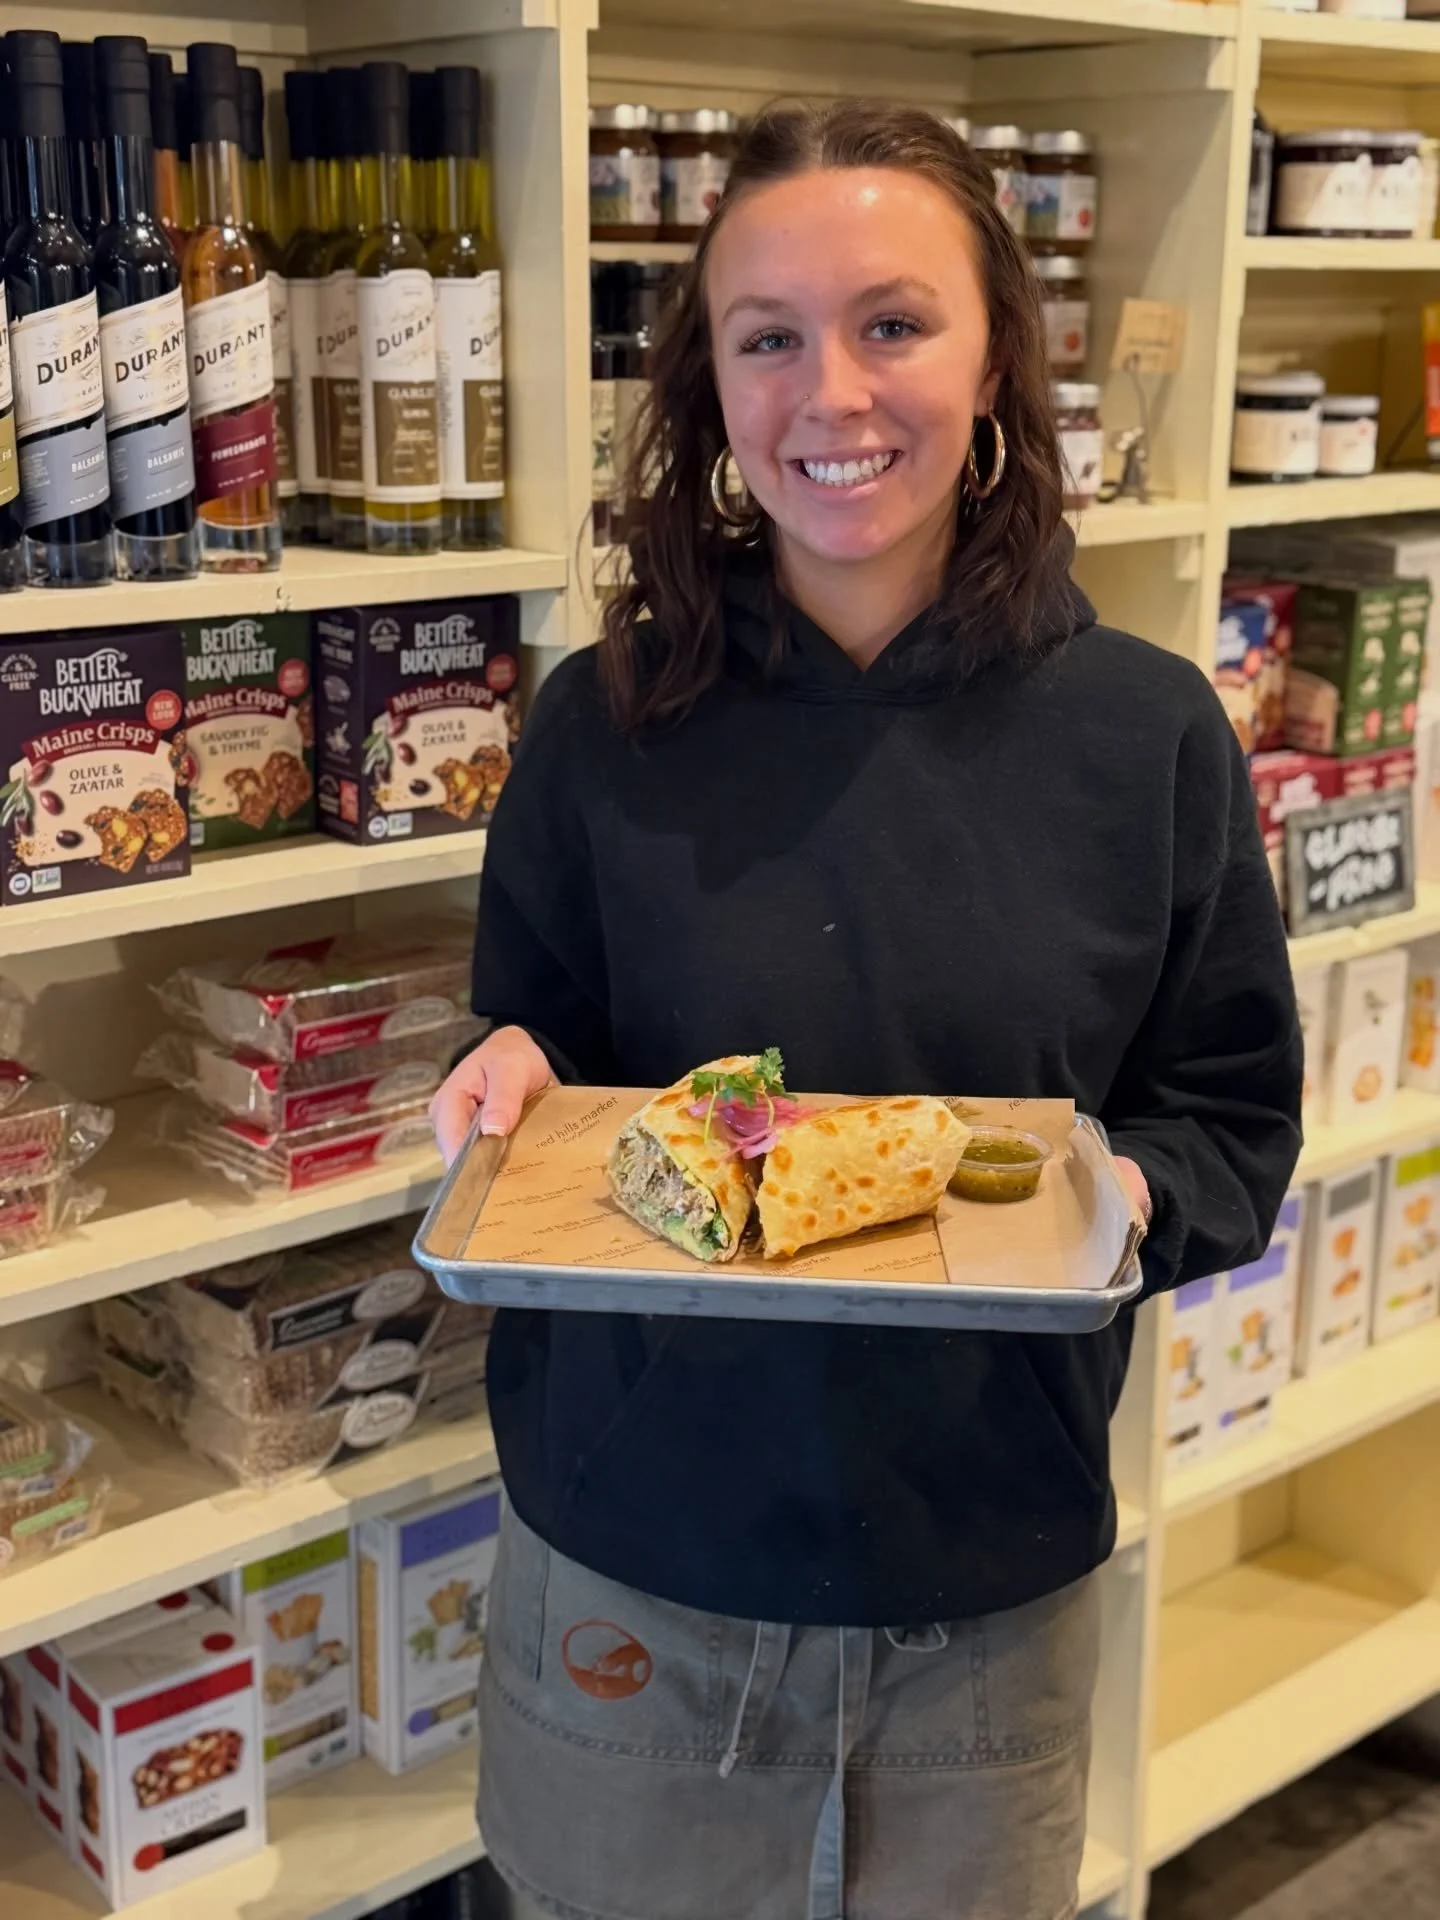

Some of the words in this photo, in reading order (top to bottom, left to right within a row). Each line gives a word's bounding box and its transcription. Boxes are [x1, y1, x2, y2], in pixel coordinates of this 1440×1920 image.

[194, 323, 266, 377] DURANT
[326, 325, 358, 355] DUR
[376, 316, 432, 357] DURA
[37, 334, 99, 385] DURAN
[115, 329, 184, 384] DURANT
[200, 621, 257, 654] BETTER
[415, 616, 468, 648] BETTER
[56, 650, 121, 686] BETTER
[186, 647, 276, 684] BUCKWHEAT
[400, 643, 486, 677] BUCKWHEAT
[40, 679, 143, 717] BUCKWHEAT
[236, 688, 287, 711] Crisps
[392, 685, 444, 713] Maine
[446, 682, 495, 704] Crisps
[31, 727, 94, 758] Maine
[97, 722, 156, 746] Crisps
[201, 729, 248, 743] SAVORY
[221, 740, 262, 754] THYME
[69, 765, 110, 781] OLIVE
[112, 763, 123, 775] &
[69, 777, 125, 795] ZA'ATAR
[536, 1134, 556, 1150] red
[555, 1121, 580, 1140] hills
[580, 1096, 619, 1124] market
